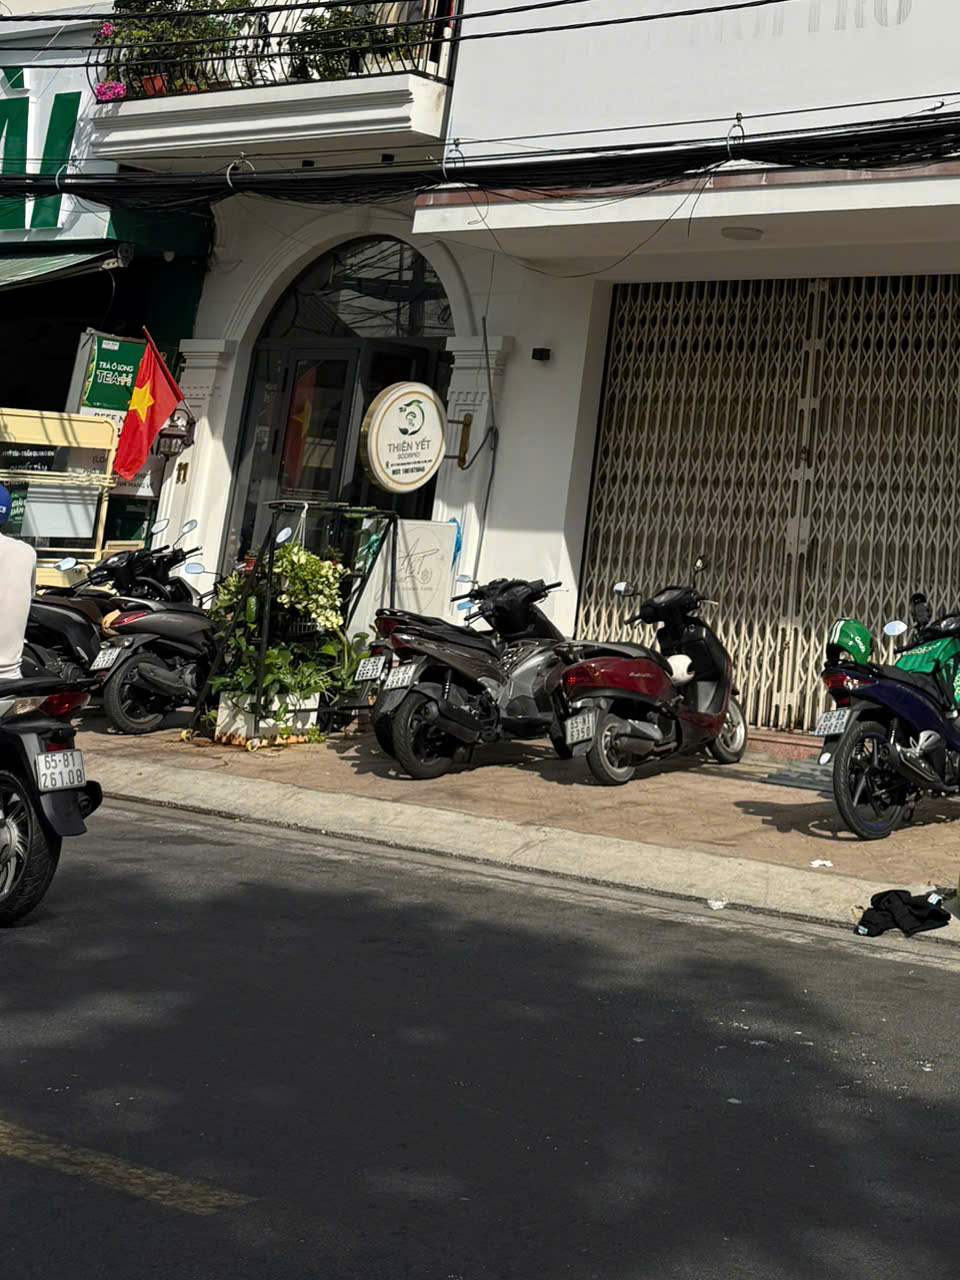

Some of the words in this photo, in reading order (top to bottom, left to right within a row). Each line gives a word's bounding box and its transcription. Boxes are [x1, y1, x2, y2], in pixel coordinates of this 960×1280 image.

[414, 436, 432, 451] YẾT
[44, 751, 75, 770] 65-B1
[42, 768, 82, 788] 261.08
